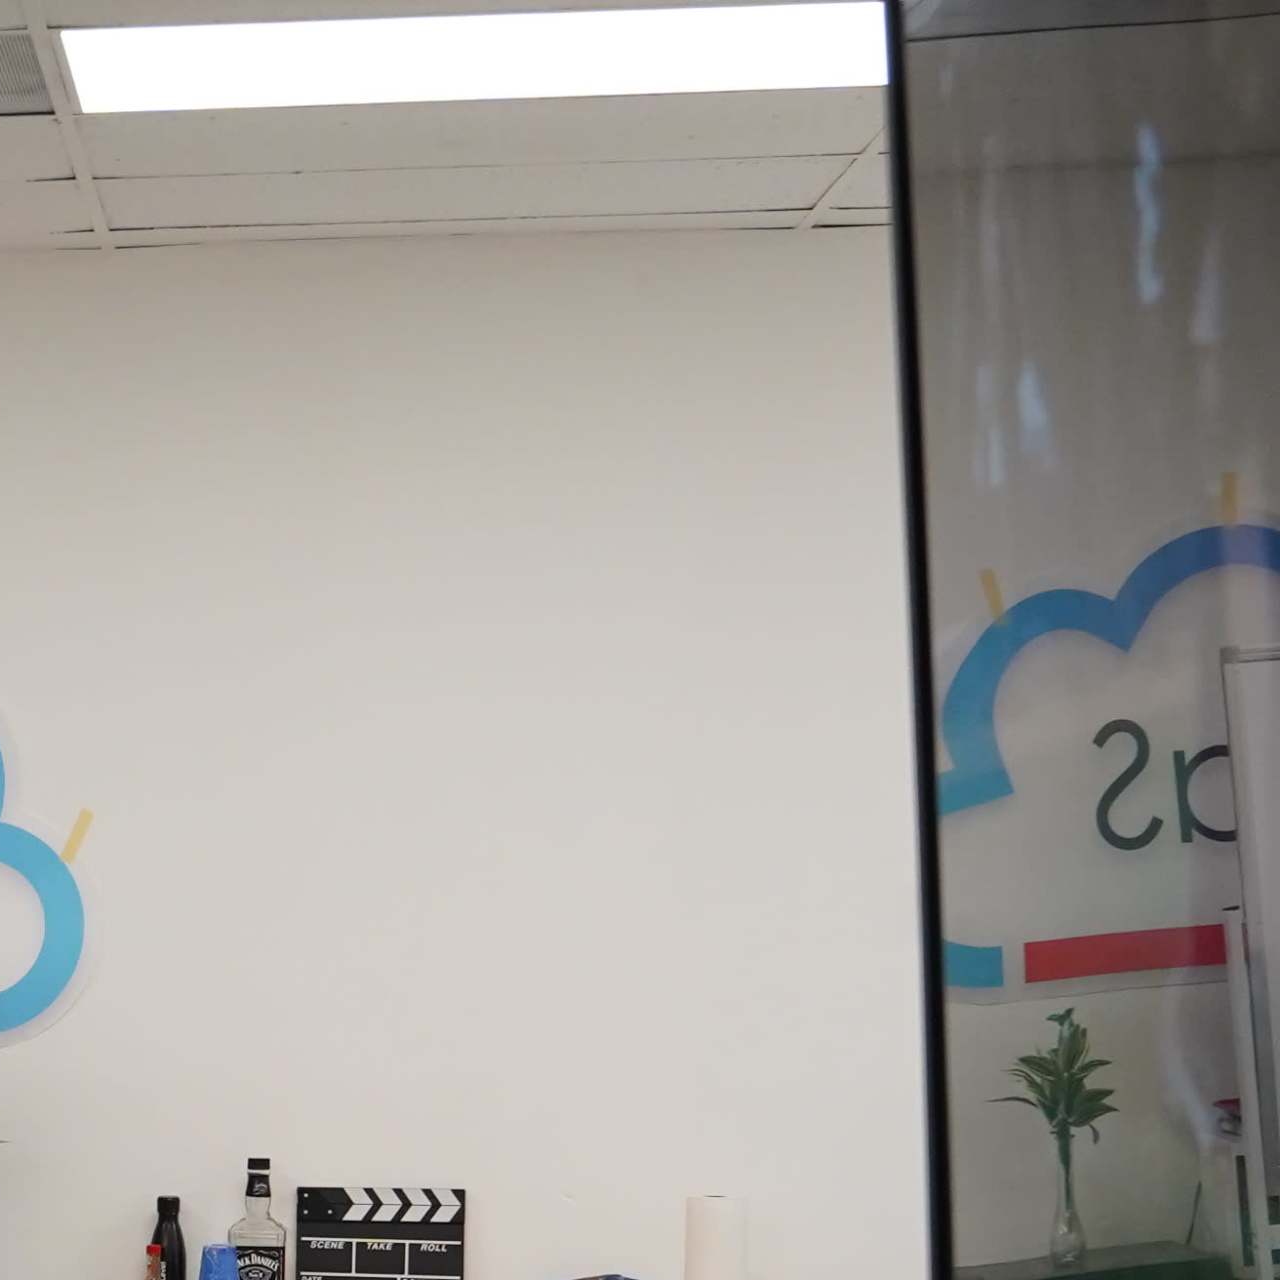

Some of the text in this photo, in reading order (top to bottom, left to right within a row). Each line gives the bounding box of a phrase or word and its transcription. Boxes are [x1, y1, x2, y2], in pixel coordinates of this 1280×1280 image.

[310, 1240, 345, 1250] SCENE
[367, 1242, 393, 1251] TAKE
[420, 1244, 447, 1253] ROLL
